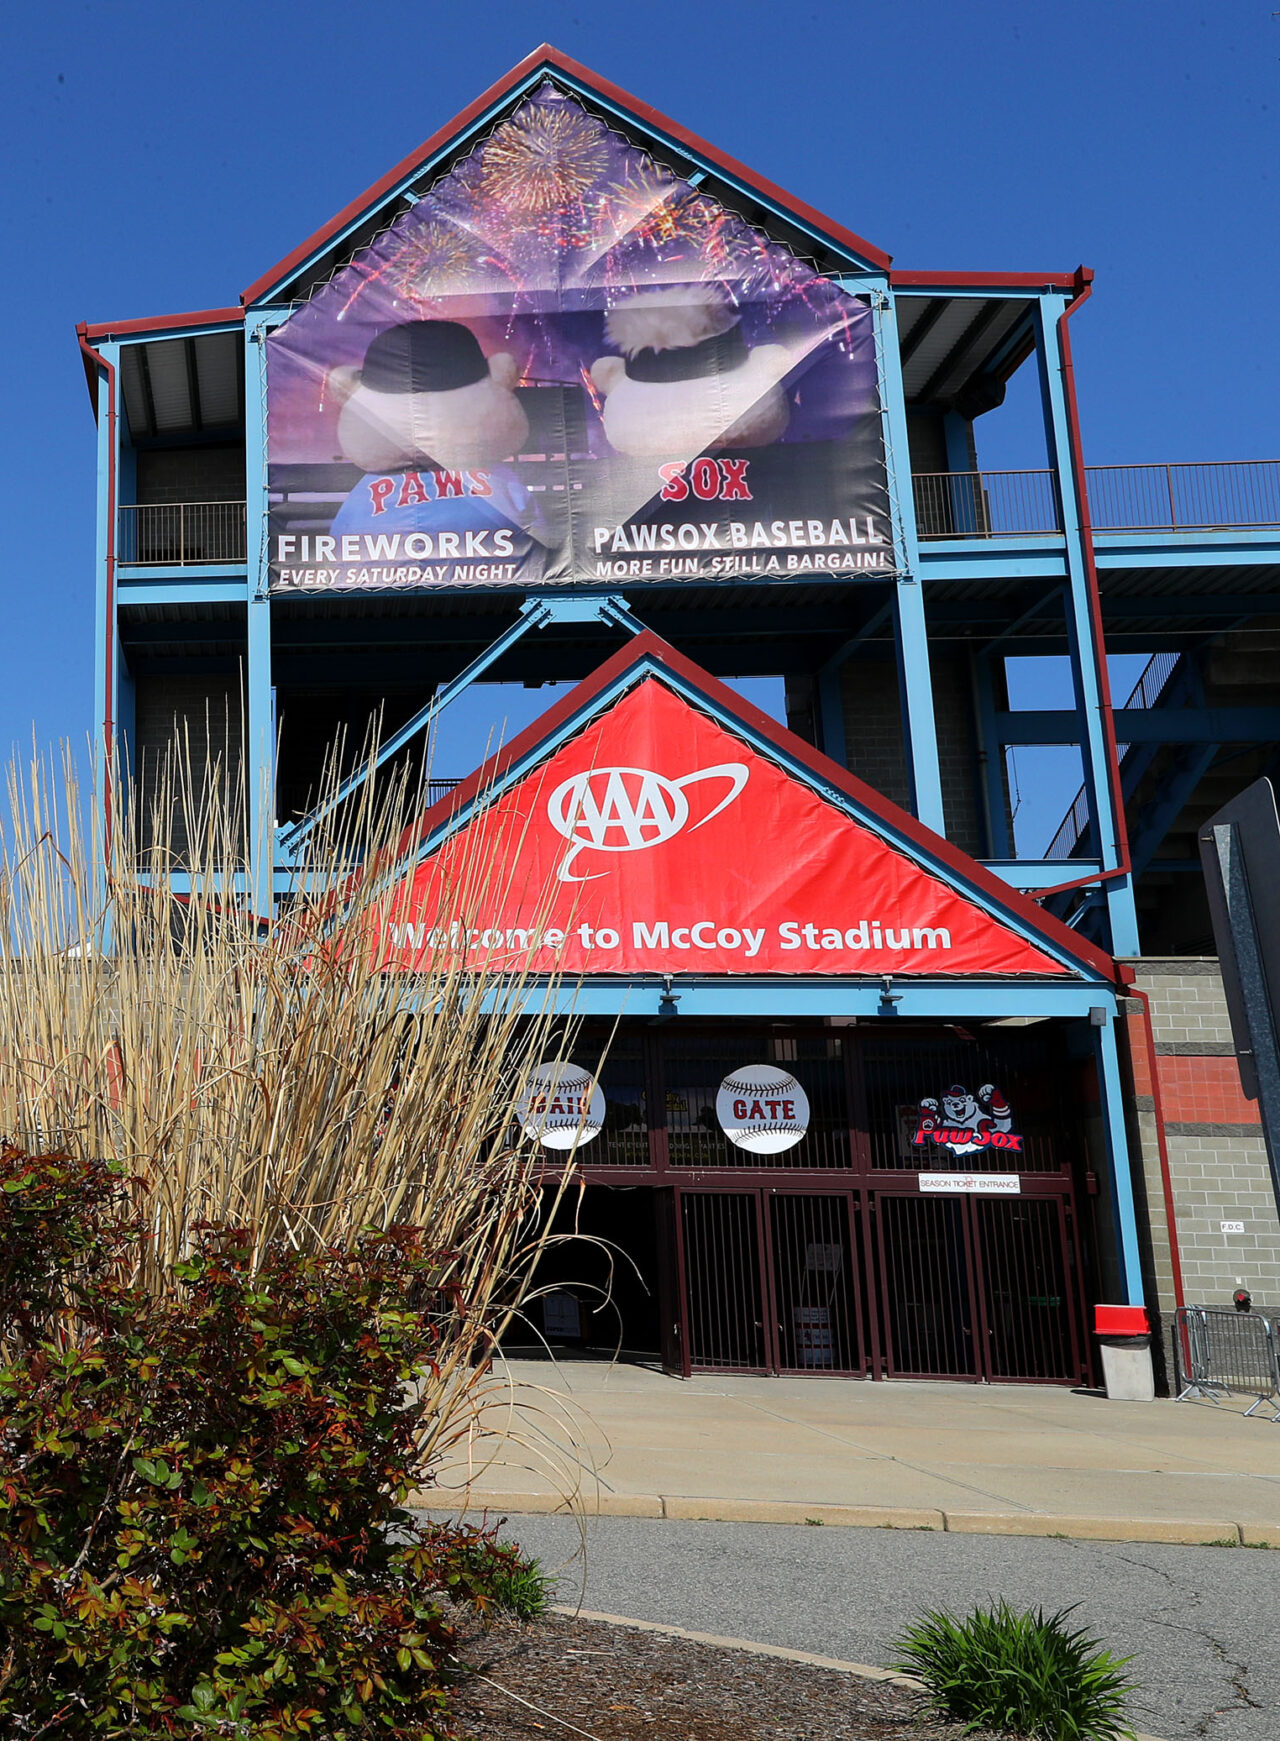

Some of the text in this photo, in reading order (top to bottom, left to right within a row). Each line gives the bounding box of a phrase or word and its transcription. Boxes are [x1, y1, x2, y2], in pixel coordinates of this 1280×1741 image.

[369, 468, 494, 516] PAWS
[658, 457, 753, 501] SOX
[277, 529, 515, 562] FIREWORKS
[593, 516, 883, 553] PAWSOX BASEBALL
[279, 564, 516, 585] EVERY SATURDAY NIGHT
[596, 551, 885, 577] MORE FUN, STILL A BARGAIN!
[558, 768, 681, 850] AAA
[577, 922, 620, 950] to
[631, 921, 766, 957] McCoy
[778, 919, 952, 950] Stadium
[733, 1099, 796, 1120] GATE
[914, 1118, 1023, 1151] PawSox
[920, 1179, 1019, 1189] SEASON TICKET ENTRANCE
